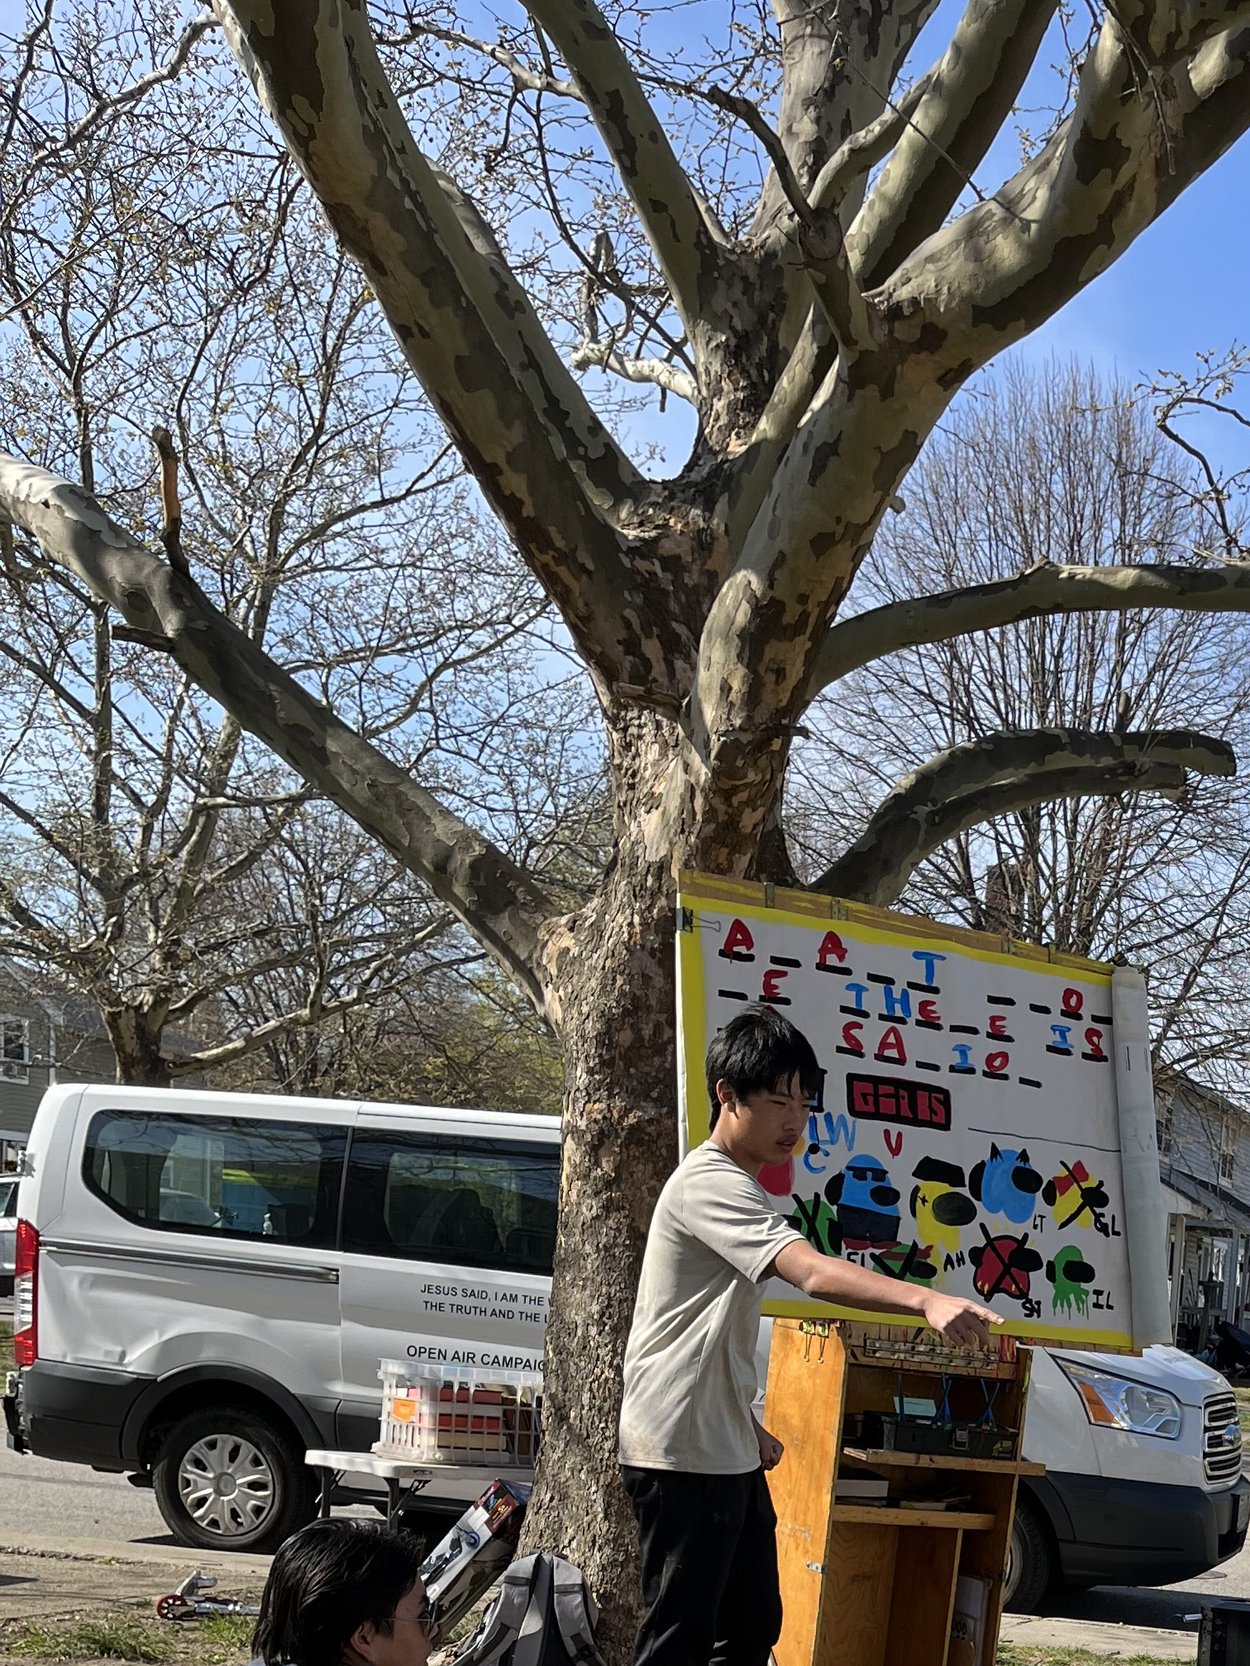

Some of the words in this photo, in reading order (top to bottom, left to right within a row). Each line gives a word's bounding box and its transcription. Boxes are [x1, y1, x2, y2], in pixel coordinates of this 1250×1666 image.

[420, 1283, 458, 1297] JESUS
[461, 1288, 492, 1302] SAID,
[500, 1292, 519, 1304] AM
[522, 1294, 545, 1307] THE
[423, 1300, 446, 1313] THE
[448, 1303, 488, 1317] TRUTH
[490, 1308, 515, 1320] AND
[518, 1311, 541, 1323] THE
[406, 1344, 448, 1361] OPEN
[451, 1350, 476, 1365] AIR
